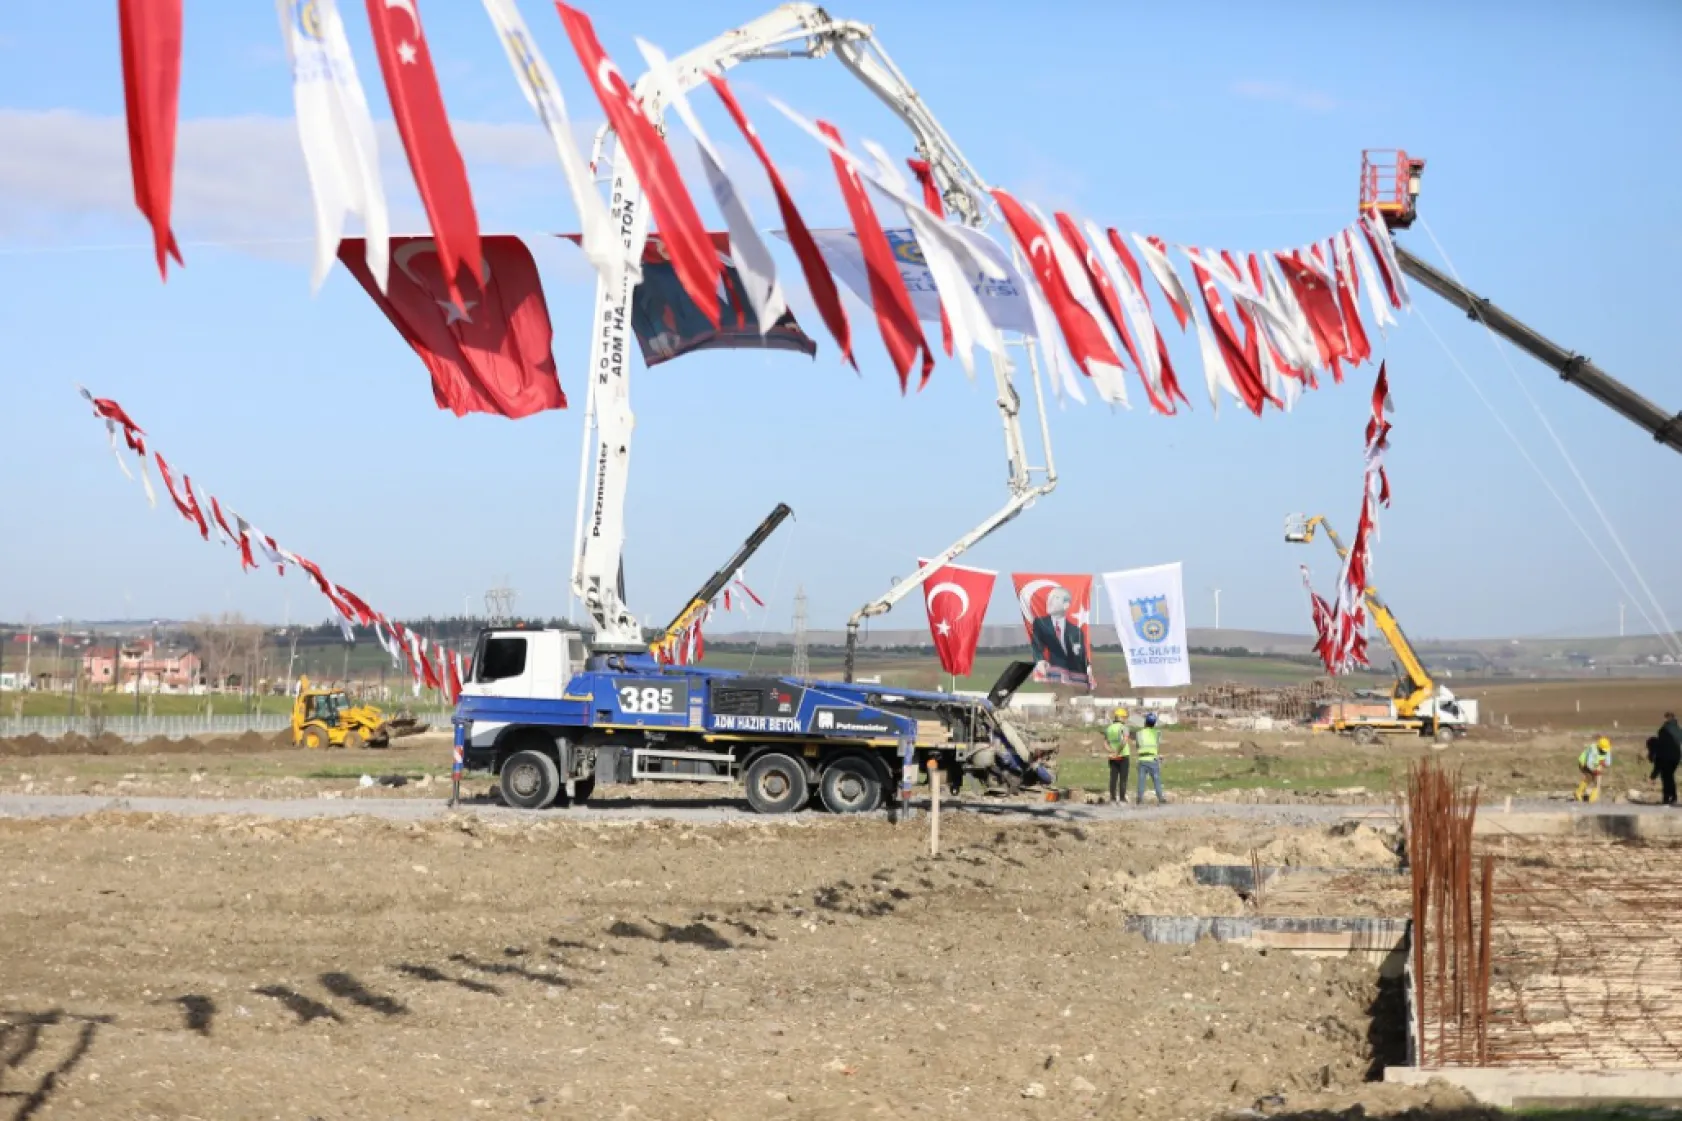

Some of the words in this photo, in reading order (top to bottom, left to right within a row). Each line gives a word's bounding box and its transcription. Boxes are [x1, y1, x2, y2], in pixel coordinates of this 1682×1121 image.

[611, 336, 624, 377] ADM
[593, 441, 608, 536] Putzmeister
[714, 715, 735, 729] ADM
[769, 717, 802, 732] BETON
[836, 721, 888, 733] Putzmeister
